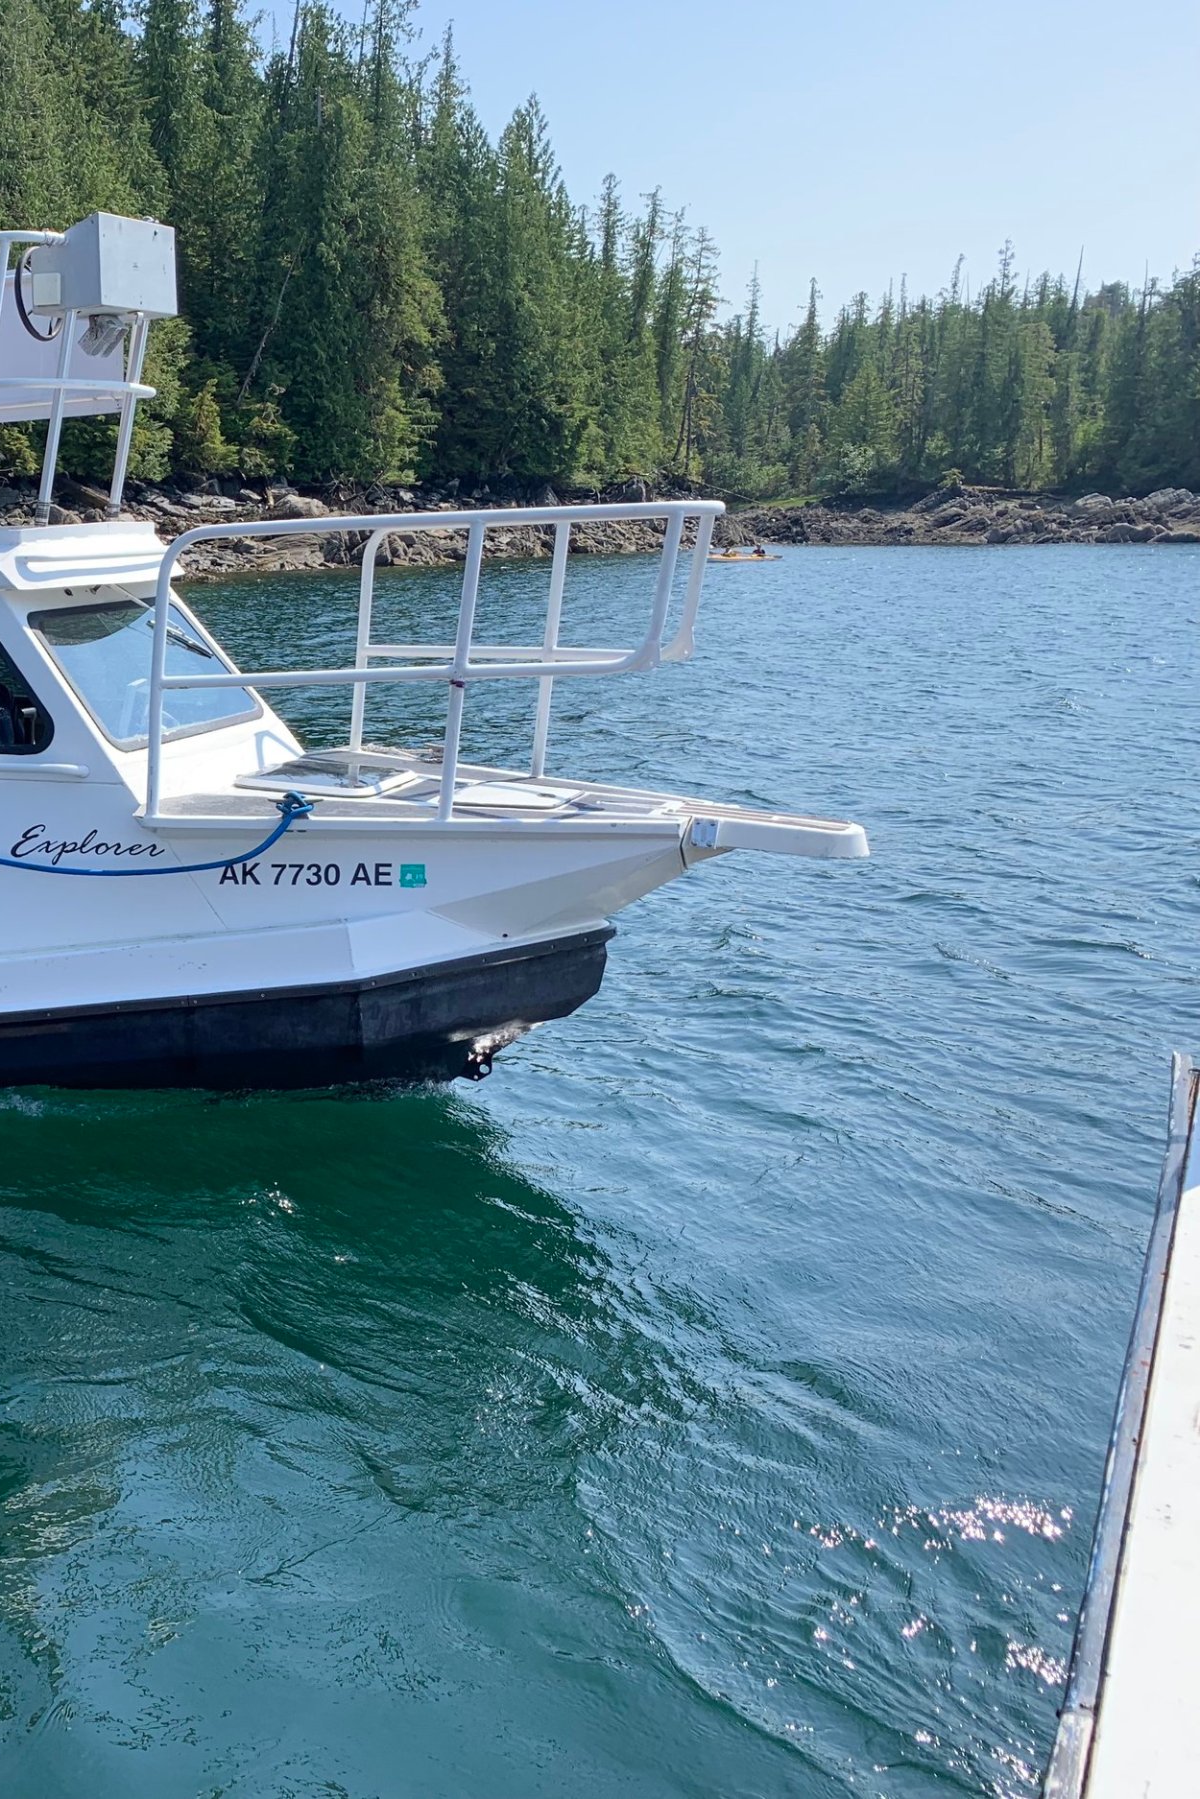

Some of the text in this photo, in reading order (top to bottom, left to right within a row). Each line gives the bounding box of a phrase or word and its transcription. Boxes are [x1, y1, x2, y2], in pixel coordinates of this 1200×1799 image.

[10, 823, 166, 866] Explorer
[219, 862, 393, 886] AK 7730 AE
